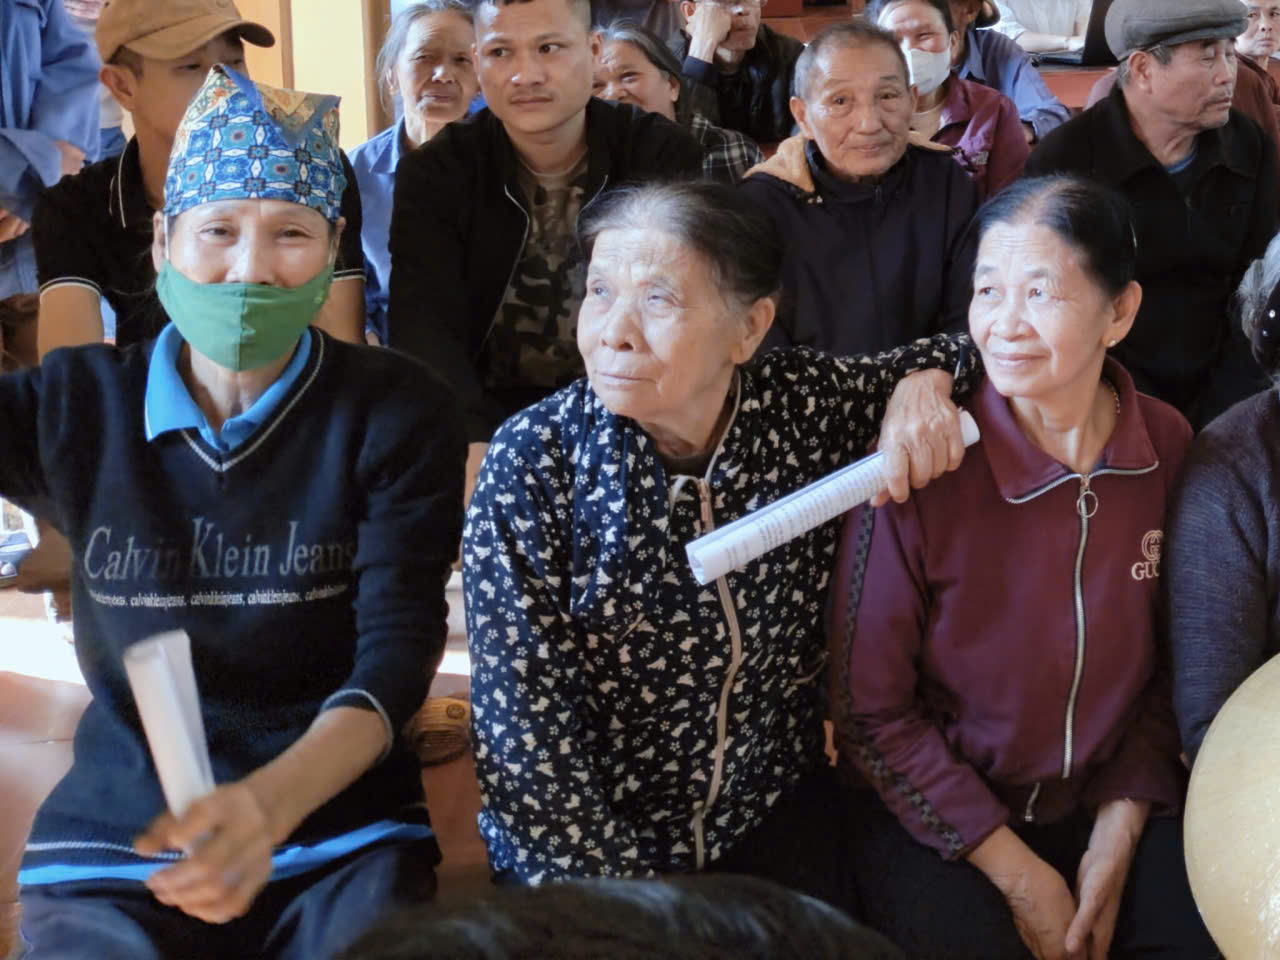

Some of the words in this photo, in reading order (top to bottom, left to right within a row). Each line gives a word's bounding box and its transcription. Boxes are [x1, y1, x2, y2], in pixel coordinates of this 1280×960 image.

[84, 526, 181, 580] Calvin
[191, 516, 271, 579] Klein
[280, 521, 354, 577] Jeans
